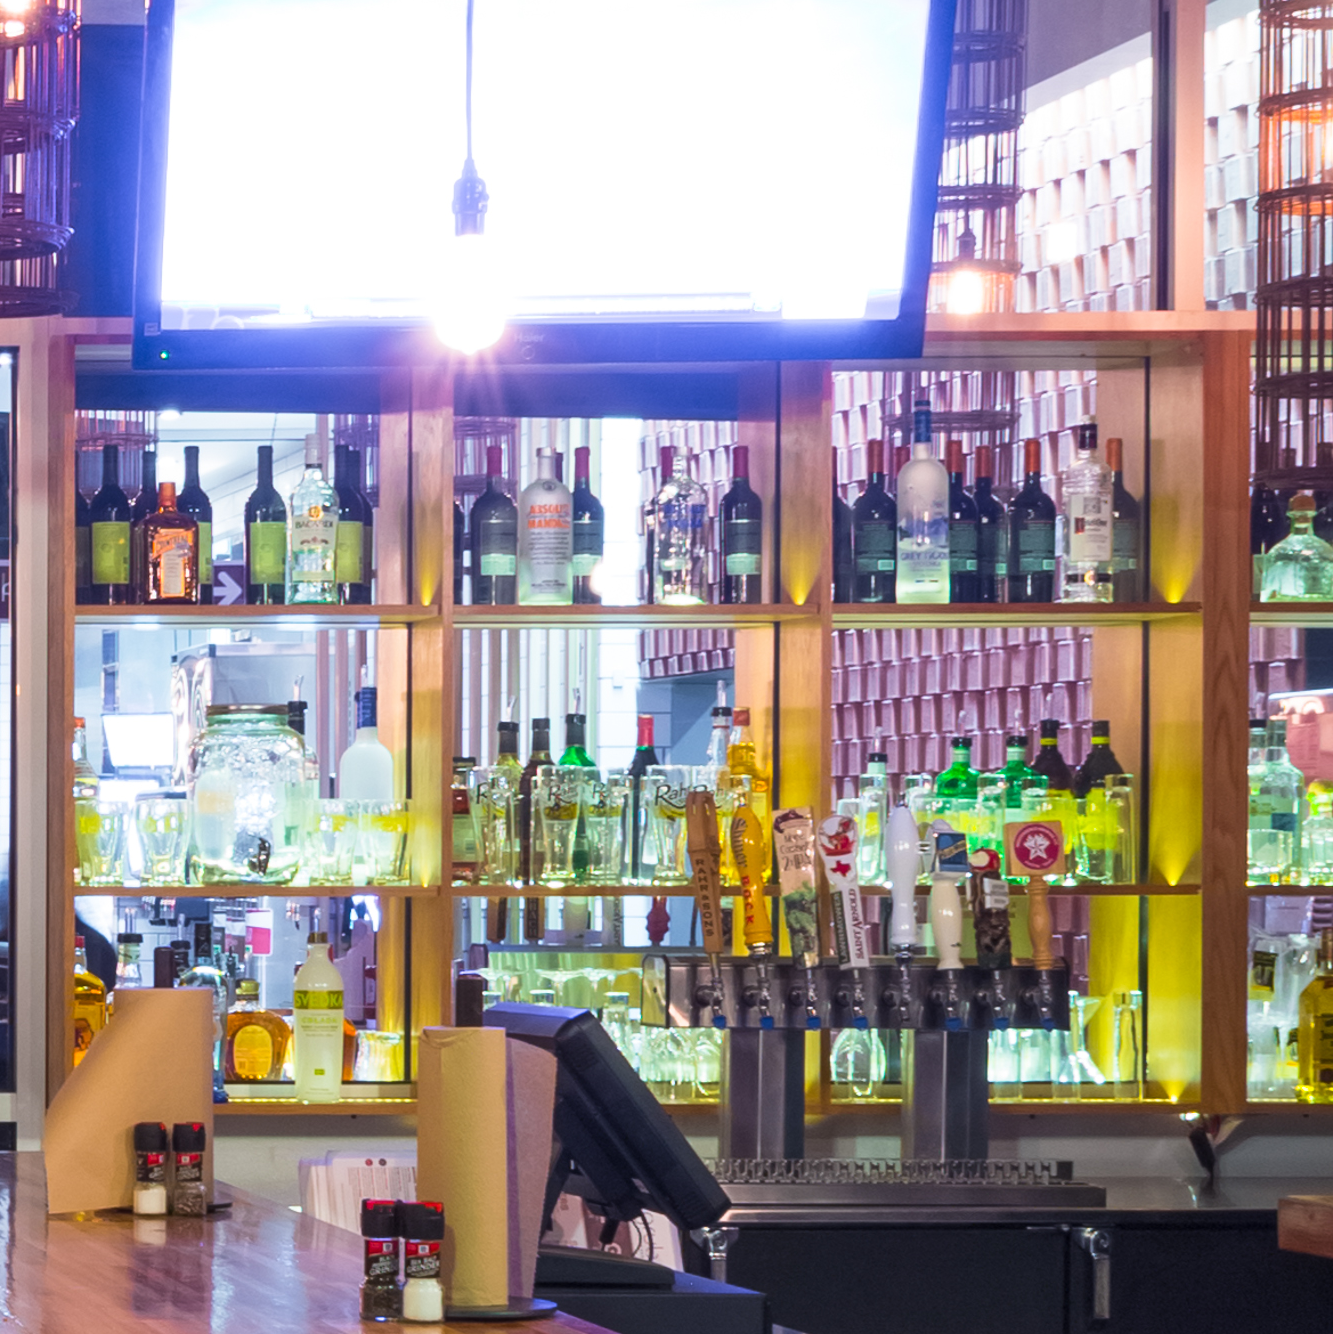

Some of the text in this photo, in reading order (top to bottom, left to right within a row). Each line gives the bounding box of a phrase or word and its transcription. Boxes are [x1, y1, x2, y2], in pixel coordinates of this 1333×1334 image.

[740, 875, 755, 925] BOCK
[848, 888, 865, 960] SAINT ARNOLD
